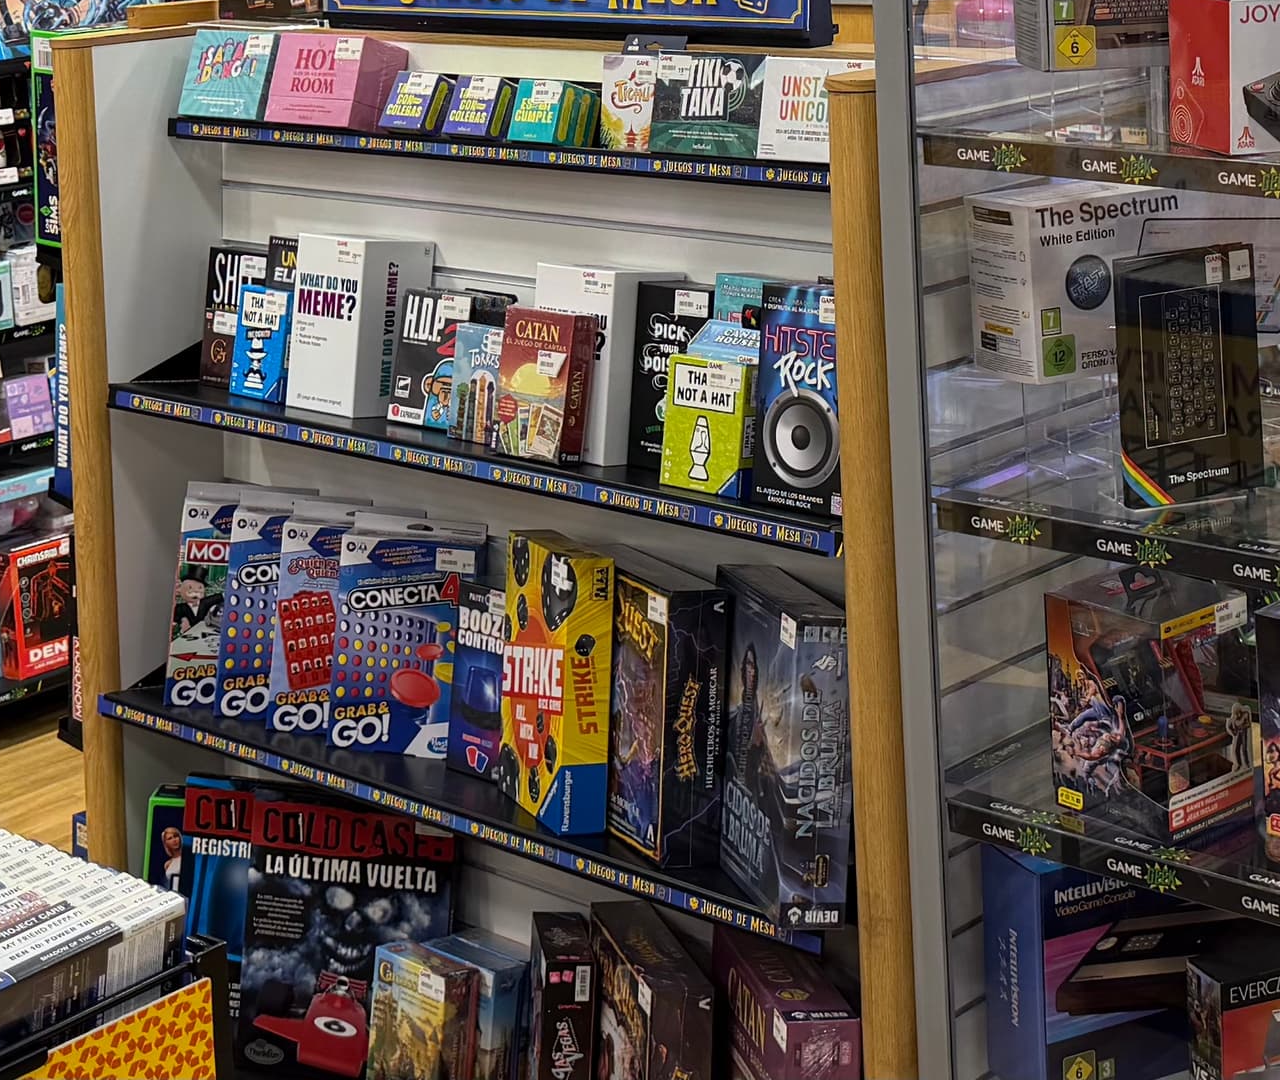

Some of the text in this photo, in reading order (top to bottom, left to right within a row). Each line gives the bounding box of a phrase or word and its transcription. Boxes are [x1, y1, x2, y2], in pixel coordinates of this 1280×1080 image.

[295, 48, 336, 70] HOT
[688, 58, 721, 83] TIKI
[290, 78, 334, 94] ROOM
[680, 87, 725, 117] TAKA
[515, 110, 553, 124] CUMPLE
[1082, 160, 1117, 174] GAME
[1218, 172, 1256, 187] GAME
[1036, 192, 1179, 229] The Spectrum
[1040, 227, 1115, 247] White Edition
[300, 272, 358, 294] WHAT DO YOU
[298, 288, 356, 321] MEME?
[515, 320, 561, 342] CATAN
[654, 322, 686, 341] PICK
[515, 338, 532, 348] JUEGO
[533, 340, 544, 349] DE
[546, 342, 567, 352] CARTAS
[677, 387, 731, 408] NOT A HAT
[1169, 465, 1229, 484] The Spectrum
[350, 575, 459, 609] CONECTA 4
[334, 702, 389, 719] GRAB&
[331, 715, 390, 747] GO!
[561, 770, 572, 832] Ravensburger
[262, 807, 342, 851] COLD
[265, 854, 437, 893] LA ÚLTIMA VUELTA
[1055, 903, 1077, 918] Video
[1076, 897, 1098, 913] Game
